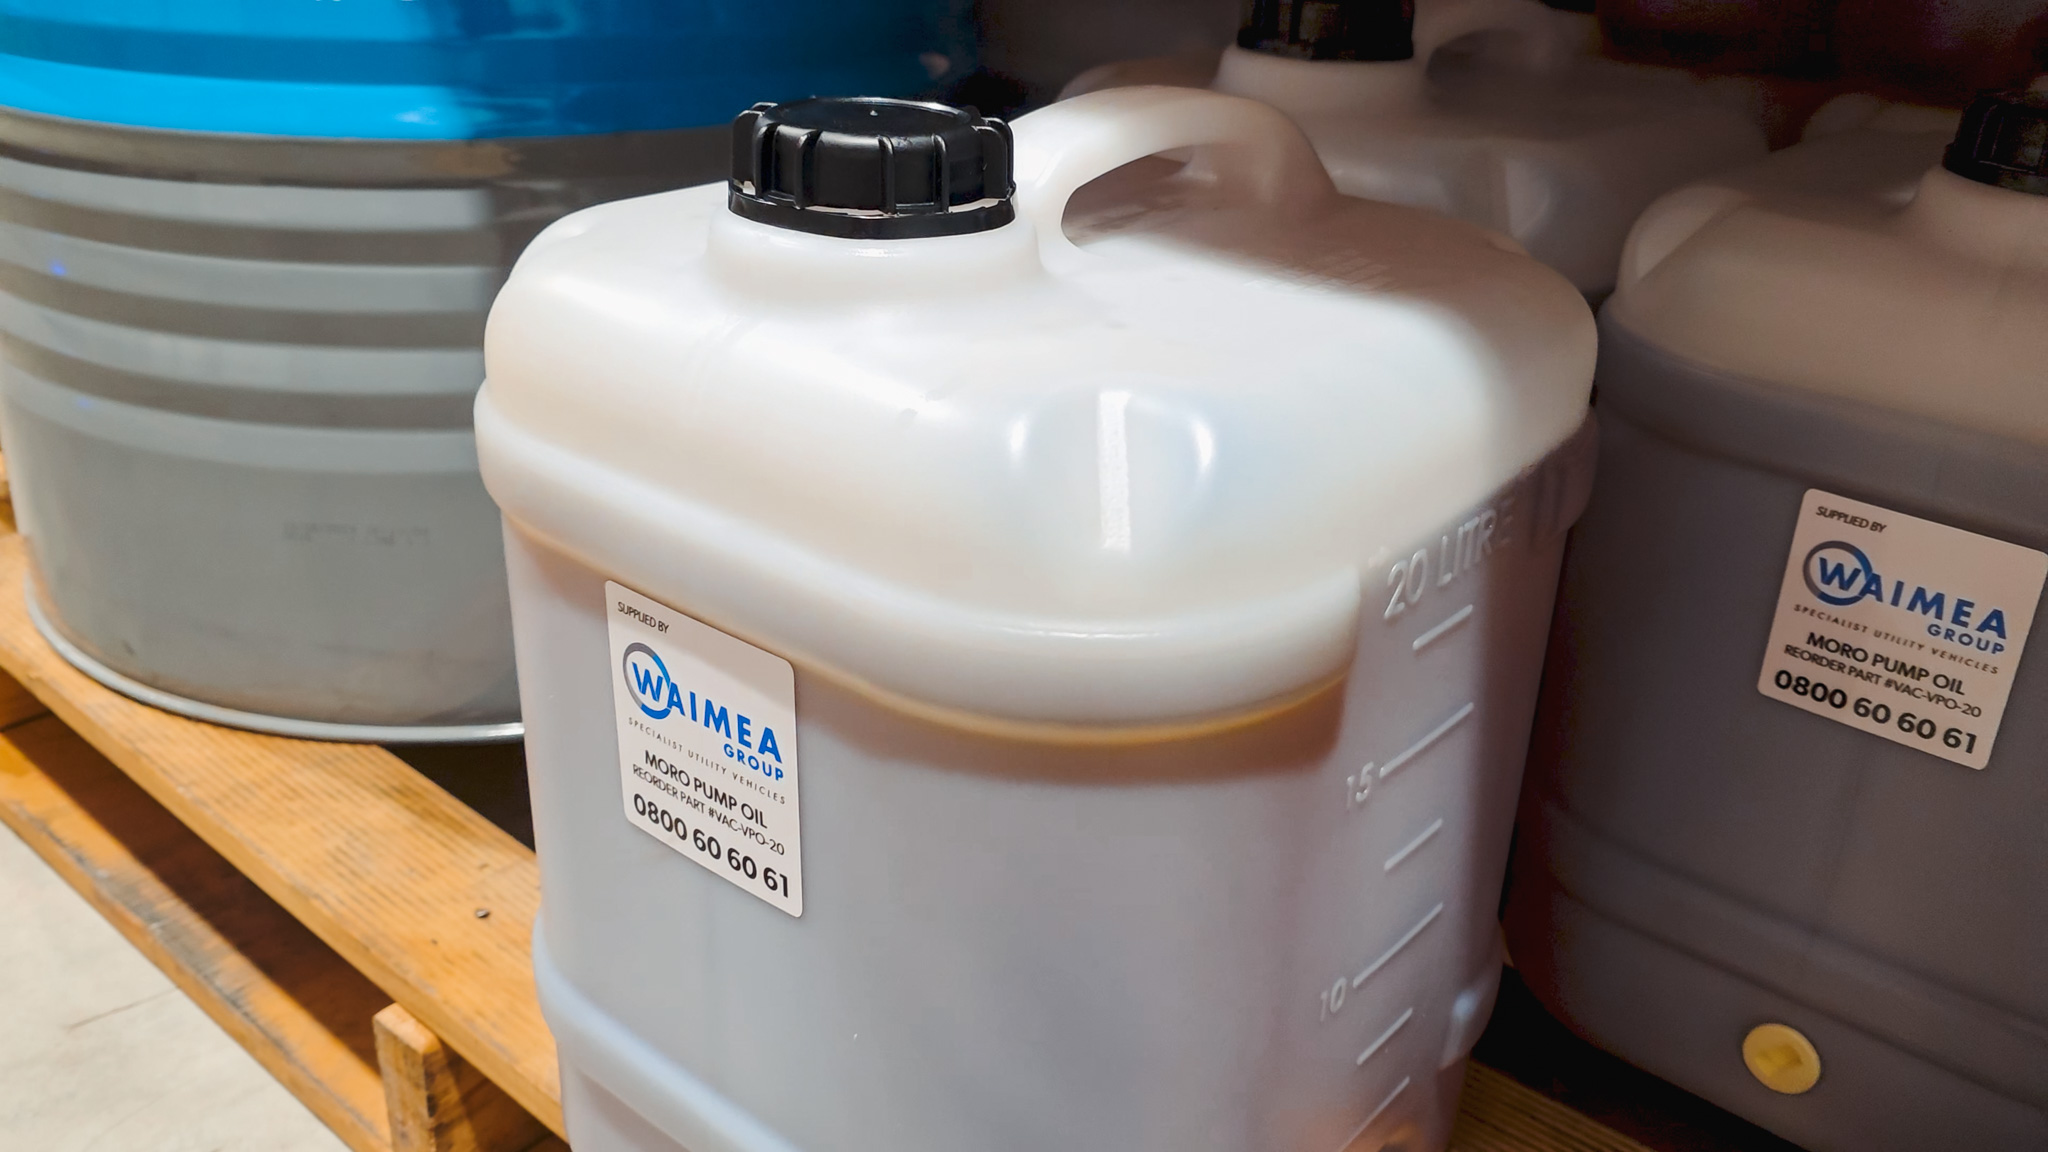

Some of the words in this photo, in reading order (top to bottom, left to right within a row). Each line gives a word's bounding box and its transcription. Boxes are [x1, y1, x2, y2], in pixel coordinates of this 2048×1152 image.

[1816, 505, 1869, 528] SUPPLIED
[1869, 521, 1887, 533] BY
[618, 601, 656, 628] SUPPLIED
[657, 622, 669, 635] BY
[1383, 548, 1428, 620] 20
[1819, 556, 2007, 640] WAIMEA
[1794, 604, 1868, 633] SPECIALIST
[1874, 630, 1925, 652] UTILITY
[1931, 648, 1999, 675] VEHICLES
[1806, 632, 1868, 663] MORO
[1871, 654, 1929, 681] PUMP
[1933, 674, 1965, 695] OIL
[1927, 623, 2005, 655] GROUP
[632, 661, 783, 764] WAIMEA
[1774, 670, 1848, 709] 0800
[1854, 697, 1891, 724] 60
[1897, 712, 1936, 740] 60
[1943, 728, 1977, 754] 61
[1784, 644, 1846, 674] REORDER
[1848, 664, 1881, 685] PART
[1884, 678, 1982, 718] #VAC-VPO-20
[628, 717, 683, 752] SPECIALIST
[688, 749, 727, 775] UTILITY
[732, 772, 786, 805] VEHICLES
[645, 750, 690, 787] MORO
[694, 777, 738, 811] PUMP
[741, 803, 768, 829] OIL
[724, 743, 784, 781] GROUP
[1346, 761, 1374, 809] 15
[633, 764, 679, 799] REORDER
[680, 789, 705, 814] PART
[708, 807, 785, 856] #VAC-VPO-20
[634, 793, 687, 841] 0800
[693, 829, 721, 860] 60
[727, 847, 757, 880] 60
[763, 867, 789, 898] 61
[1320, 976, 1347, 1022] 10
